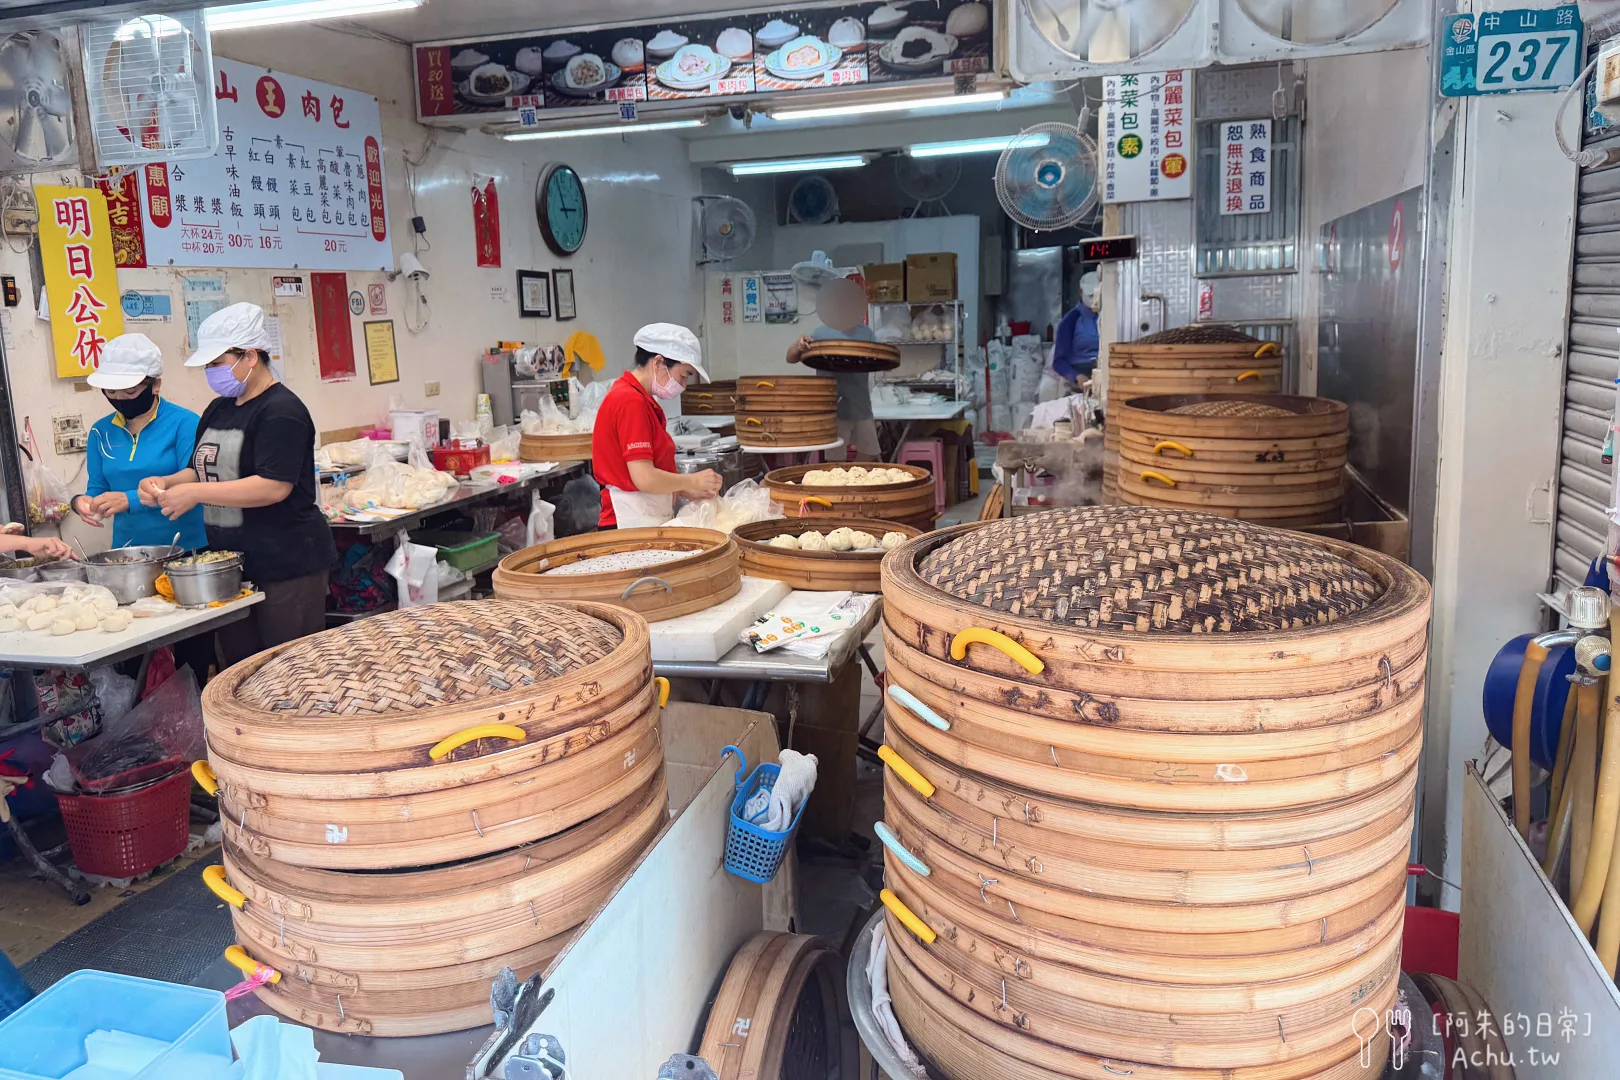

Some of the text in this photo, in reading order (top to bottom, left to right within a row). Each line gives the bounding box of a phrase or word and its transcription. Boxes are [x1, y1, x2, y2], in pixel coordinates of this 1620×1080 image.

[1484, 9, 1574, 30] 中山路
[1445, 45, 1476, 56] 金山區
[1483, 36, 1571, 84] 237
[608, 87, 643, 100] 高麗菜包
[832, 70, 861, 83] 魯肉包
[215, 70, 350, 129] 山王肉包
[520, 109, 536, 126] 葷
[619, 102, 636, 120] 葷
[1164, 69, 1183, 148] 高麗菜包
[274, 134, 283, 149] 素
[336, 145, 344, 158] 葷
[1121, 137, 1139, 155] 素
[223, 126, 244, 218] 古早味油飯
[249, 147, 265, 219] 紅饅頭
[1164, 156, 1183, 174] 葷
[1226, 125, 1244, 212] 恕無法退換
[1249, 123, 1267, 210] 熟食商品
[264, 150, 281, 220] 白饅頭
[286, 152, 302, 222] 素菜包
[300, 156, 316, 223] 紅豆包
[317, 158, 331, 224] 高麗菜包
[329, 160, 345, 225] 酸菜包
[343, 161, 357, 226] 魯味肉包
[366, 146, 384, 233] 歡迎光臨
[181, 228, 223, 241] 大杯24元
[181, 241, 224, 254] 中杯20元
[228, 234, 253, 249] 30元
[259, 236, 282, 250] 16元
[324, 239, 347, 253] 20元
[1391, 210, 1400, 261] 2
[54, 198, 106, 369] 明日公休
[746, 278, 757, 304] 免費
